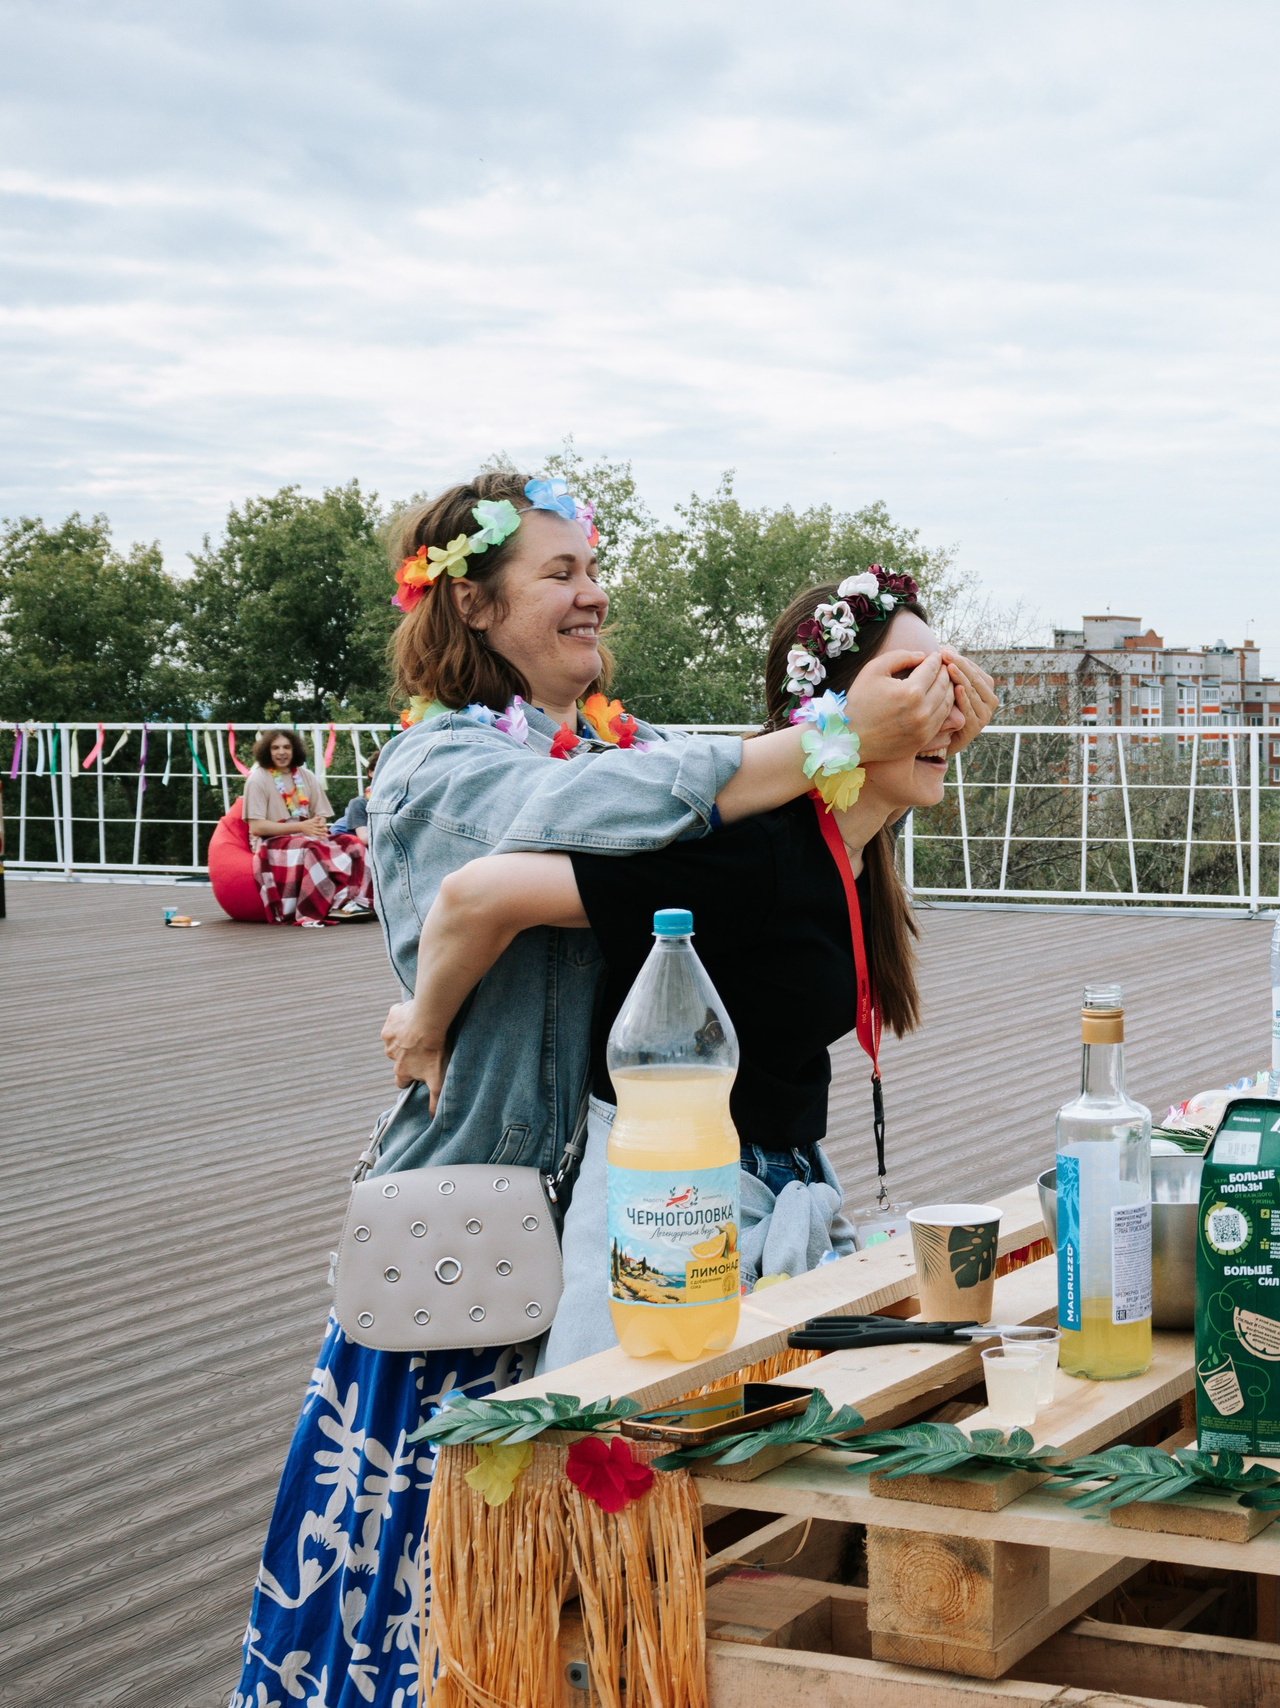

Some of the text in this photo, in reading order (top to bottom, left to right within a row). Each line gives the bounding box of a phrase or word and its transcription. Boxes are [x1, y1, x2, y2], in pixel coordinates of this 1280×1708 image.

[1229, 1169, 1276, 1183] БОЛЬШЕ
[1220, 1182, 1263, 1194] ПОЛЬЗЫ
[627, 1203, 734, 1227] ЧЕРНОГОЛОВКА
[700, 1224, 715, 1239] вкус
[690, 1258, 739, 1279] ЛИМОНАД
[1224, 1265, 1273, 1276] БОЛЬШЕ
[1067, 1245, 1075, 1322] MADRUZZO
[1258, 1277, 1280, 1286] СИЛ
